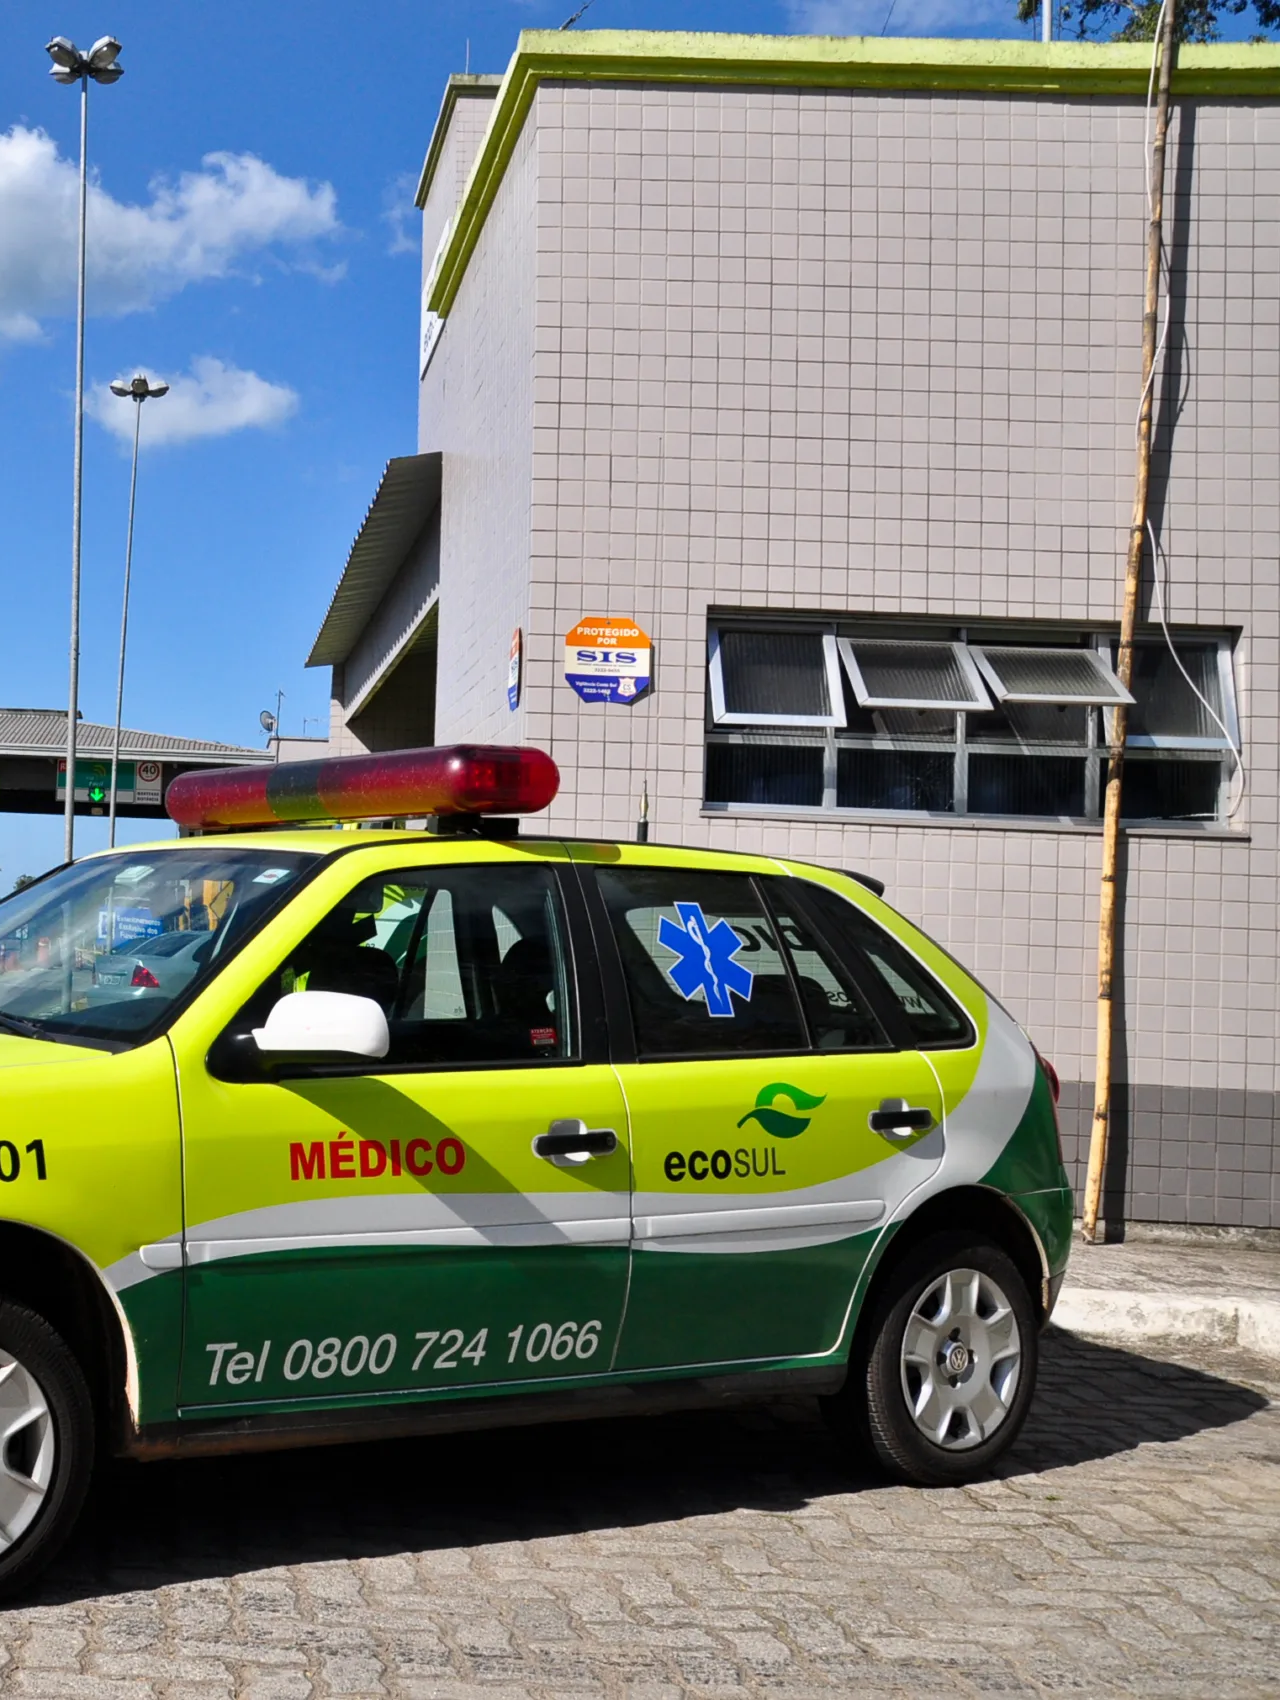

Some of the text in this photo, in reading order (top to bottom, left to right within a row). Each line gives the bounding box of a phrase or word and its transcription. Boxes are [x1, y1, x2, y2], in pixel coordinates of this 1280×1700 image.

[577, 627, 639, 637] PROTEGIDO
[597, 637, 617, 645] POR
[577, 650, 637, 664] SIS
[142, 765, 156, 775] 40
[118, 922, 146, 933] Exclusivo
[146, 927, 158, 935] dos
[290, 1131, 466, 1181] MÉDICO
[204, 1319, 602, 1386] Tel 0800 724 1066
